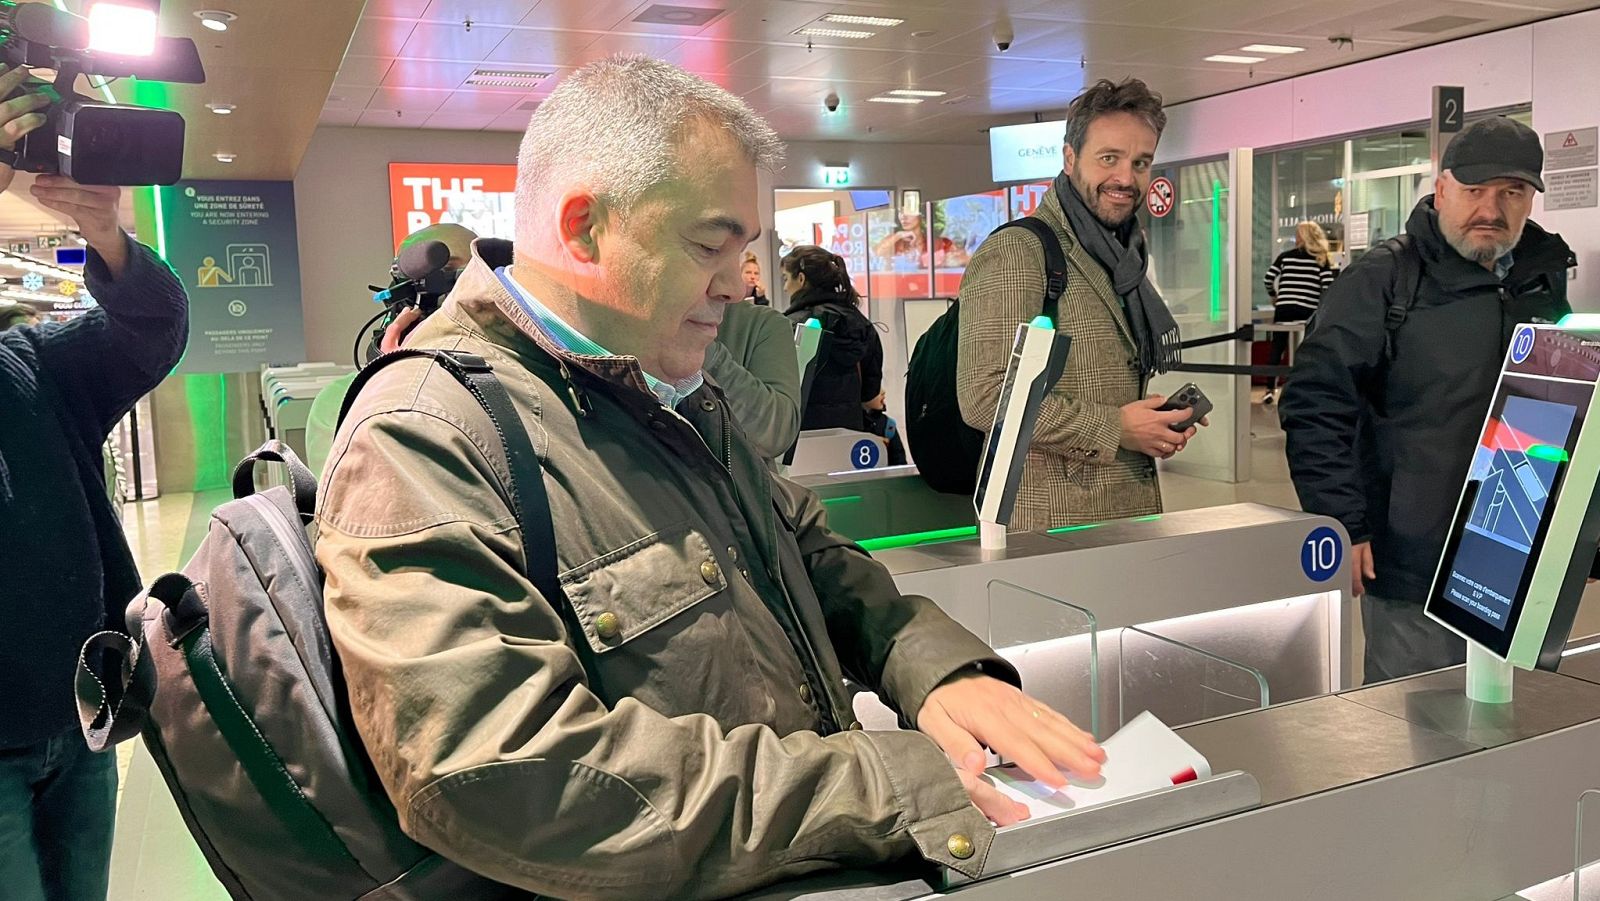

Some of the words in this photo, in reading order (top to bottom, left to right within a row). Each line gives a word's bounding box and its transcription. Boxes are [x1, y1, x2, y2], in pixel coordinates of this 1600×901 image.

[1445, 98, 1457, 124] 2
[402, 177, 484, 210] THE
[1515, 334, 1530, 355] 10
[859, 445, 871, 465] 8
[1308, 536, 1336, 572] 10
